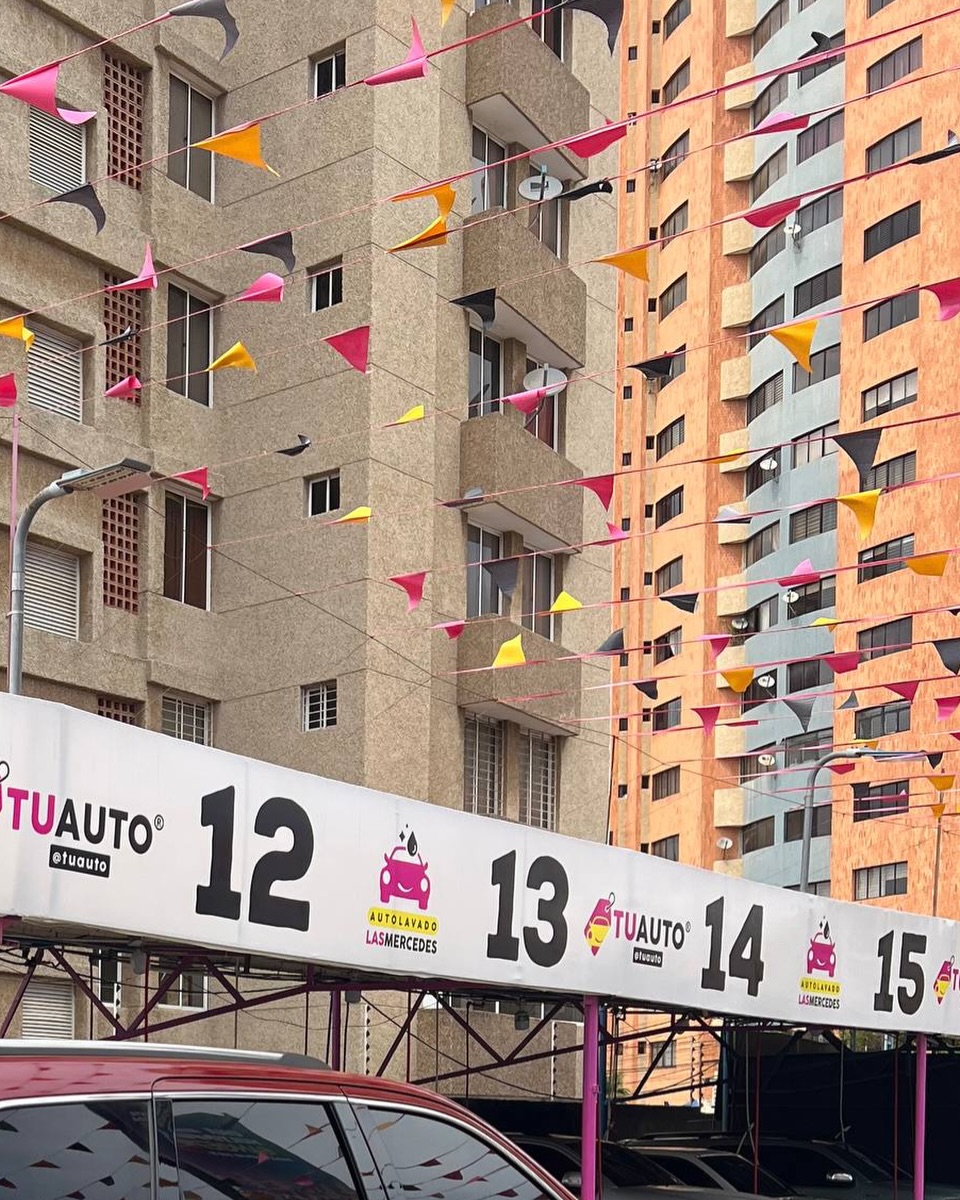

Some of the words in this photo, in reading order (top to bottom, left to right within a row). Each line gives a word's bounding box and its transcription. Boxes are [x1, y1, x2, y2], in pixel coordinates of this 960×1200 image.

[52, 851, 107, 873] @tuauto
[195, 785, 315, 932] 12
[370, 911, 437, 931] AUTOLAVADO
[486, 849, 569, 968] 13
[366, 930, 437, 954] LASMERCEDES
[701, 896, 765, 997] 14
[800, 980, 840, 994] AUTOLAVADO
[874, 930, 927, 1015] 15
